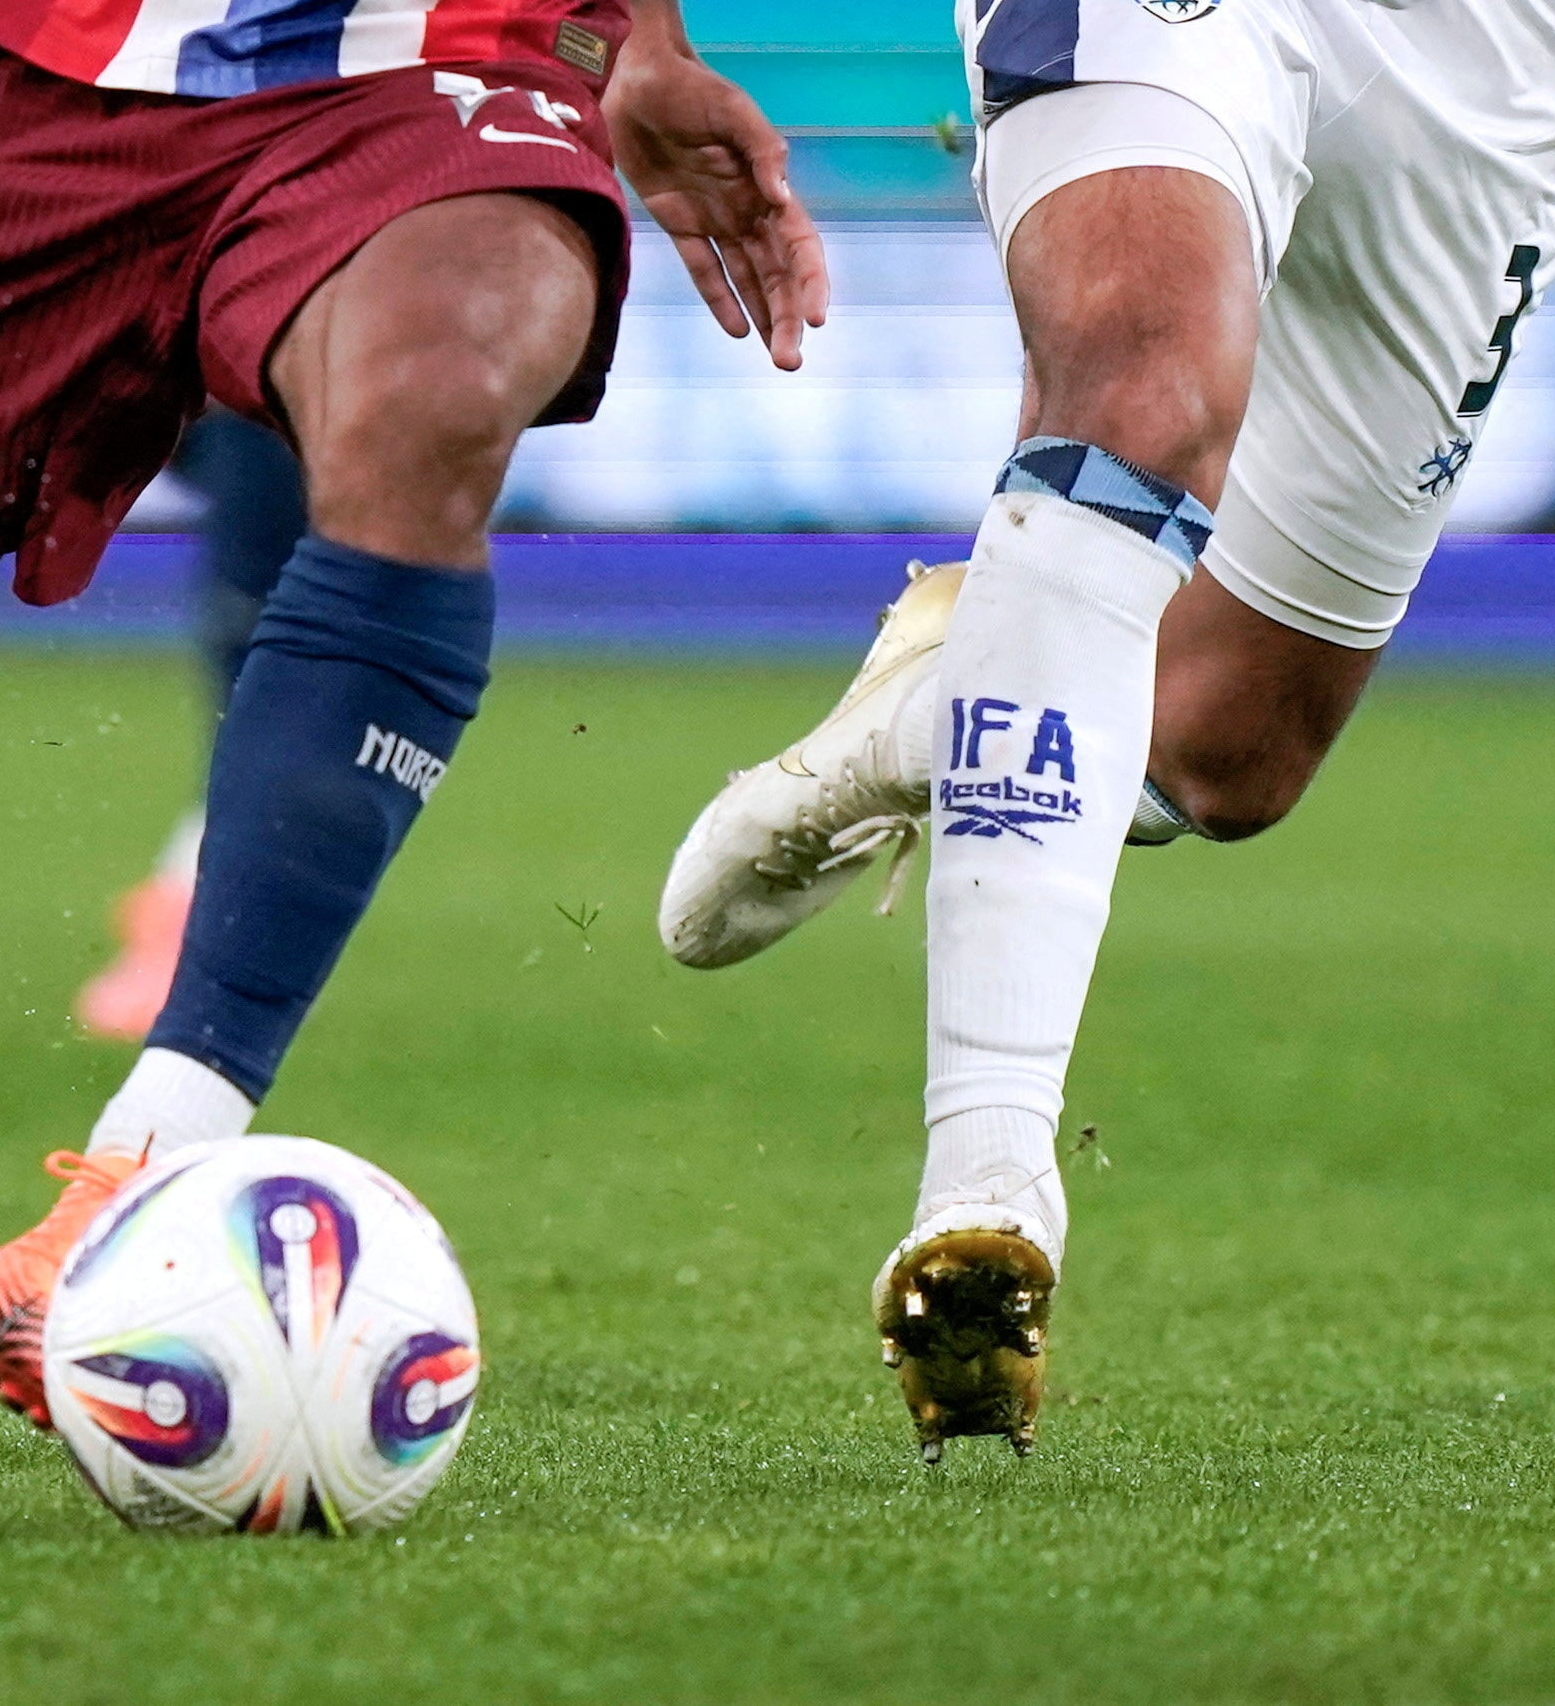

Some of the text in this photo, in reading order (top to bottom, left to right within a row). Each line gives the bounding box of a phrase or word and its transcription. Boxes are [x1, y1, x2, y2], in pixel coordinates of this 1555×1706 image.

[1456, 244, 1541, 418] 3
[950, 697, 1076, 784] IFA
[940, 775, 1083, 817] Reebok
